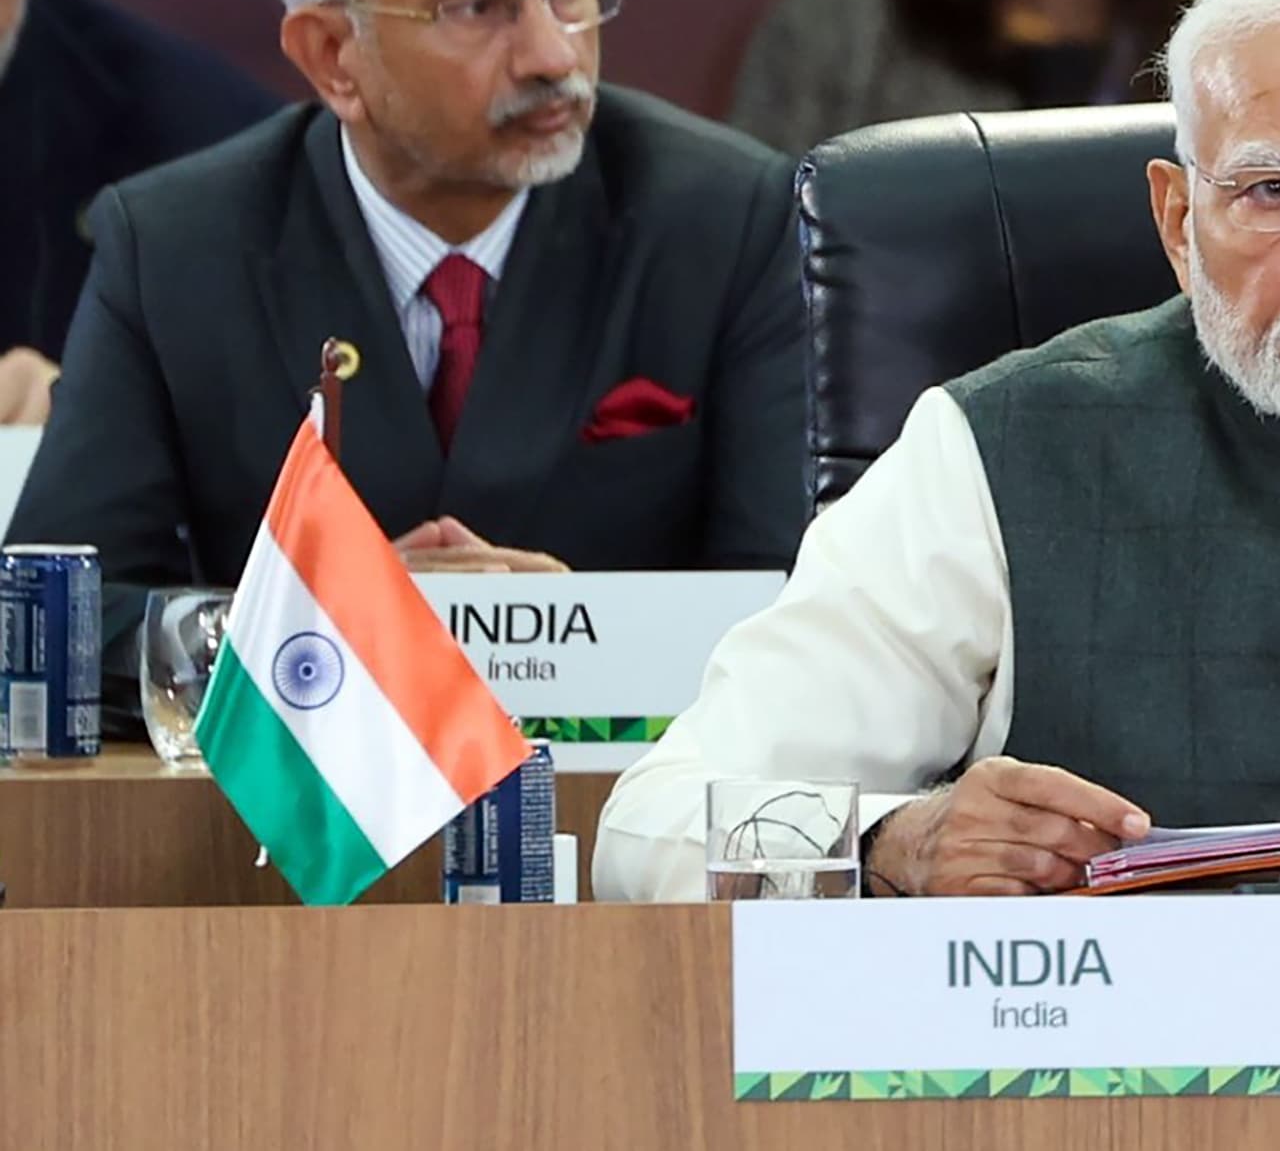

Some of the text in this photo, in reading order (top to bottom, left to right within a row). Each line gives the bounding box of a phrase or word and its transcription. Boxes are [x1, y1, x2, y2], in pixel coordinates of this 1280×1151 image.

[449, 603, 598, 645] INDIA
[488, 653, 557, 681] Índia
[947, 938, 1113, 988] INDIA
[992, 997, 1069, 1029] Índia
